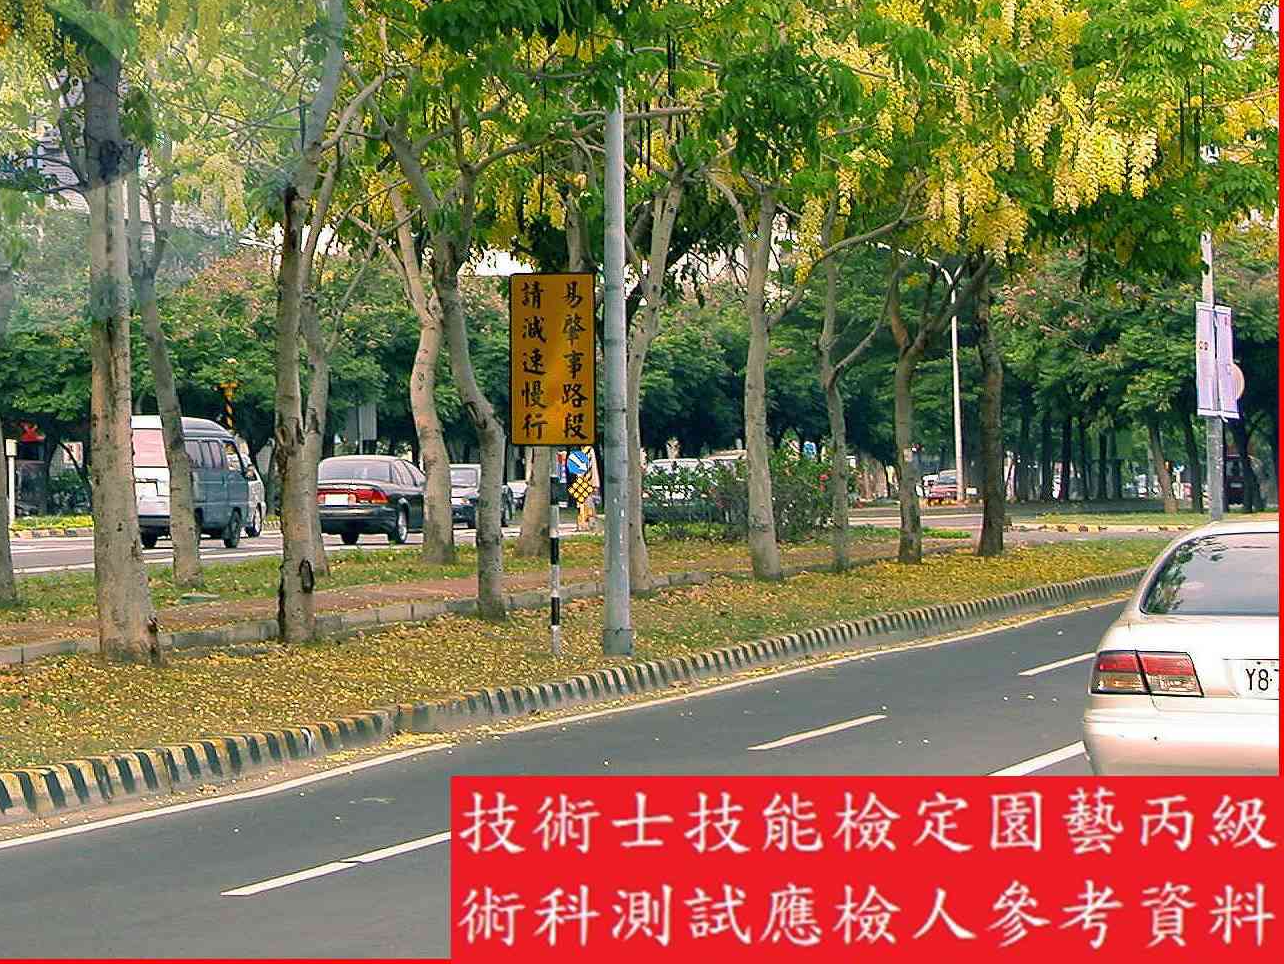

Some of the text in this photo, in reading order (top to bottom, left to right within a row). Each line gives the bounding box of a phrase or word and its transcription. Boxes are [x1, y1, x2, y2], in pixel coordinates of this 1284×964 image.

[522, 281, 546, 439] 請減速慢行
[563, 282, 588, 439] 易肇事路段
